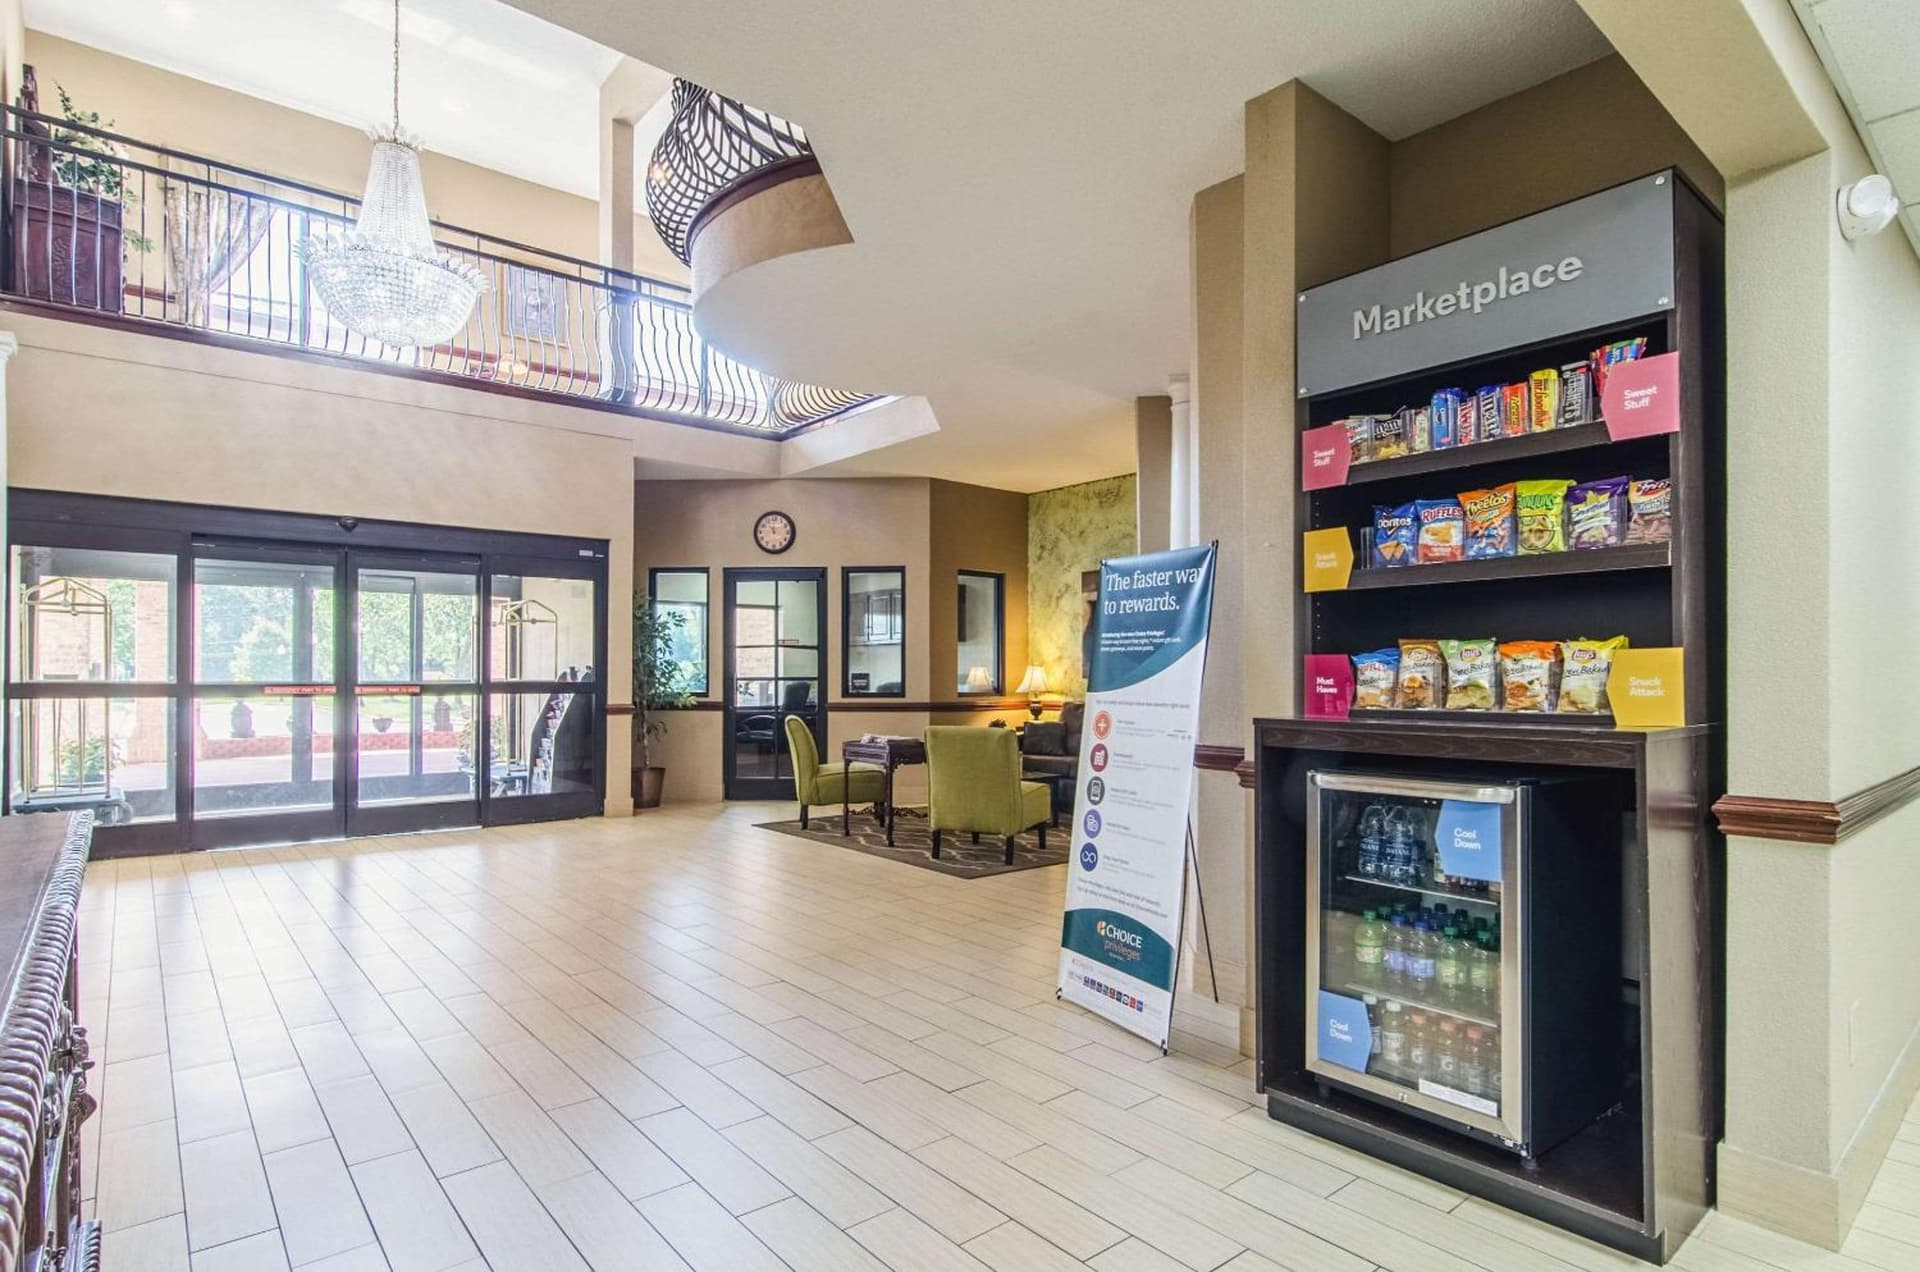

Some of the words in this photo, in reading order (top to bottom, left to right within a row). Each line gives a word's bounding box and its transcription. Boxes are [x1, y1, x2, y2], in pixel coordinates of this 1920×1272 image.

[1353, 256, 1584, 340] Marketplace
[1623, 386, 1658, 400] Sweet
[1623, 397, 1651, 411] Stuff
[1312, 448, 1336, 459] Sweet
[1313, 456, 1331, 468] Stuff
[1467, 493, 1508, 519] Cheetos
[1422, 506, 1464, 522] RUFFLES
[1106, 572, 1130, 592] The
[1132, 570, 1172, 589] faster
[1104, 600, 1117, 615] to
[1119, 591, 1180, 614] rewards.
[1316, 677, 1334, 685] Must
[1316, 685, 1338, 694] Haves
[1454, 827, 1477, 839] Cool
[1454, 838, 1481, 851] Down
[1106, 924, 1143, 949] CHOICE
[1329, 1018, 1349, 1031] Cool
[1329, 1028, 1353, 1043] Down
[1441, 1057, 1454, 1071] G
